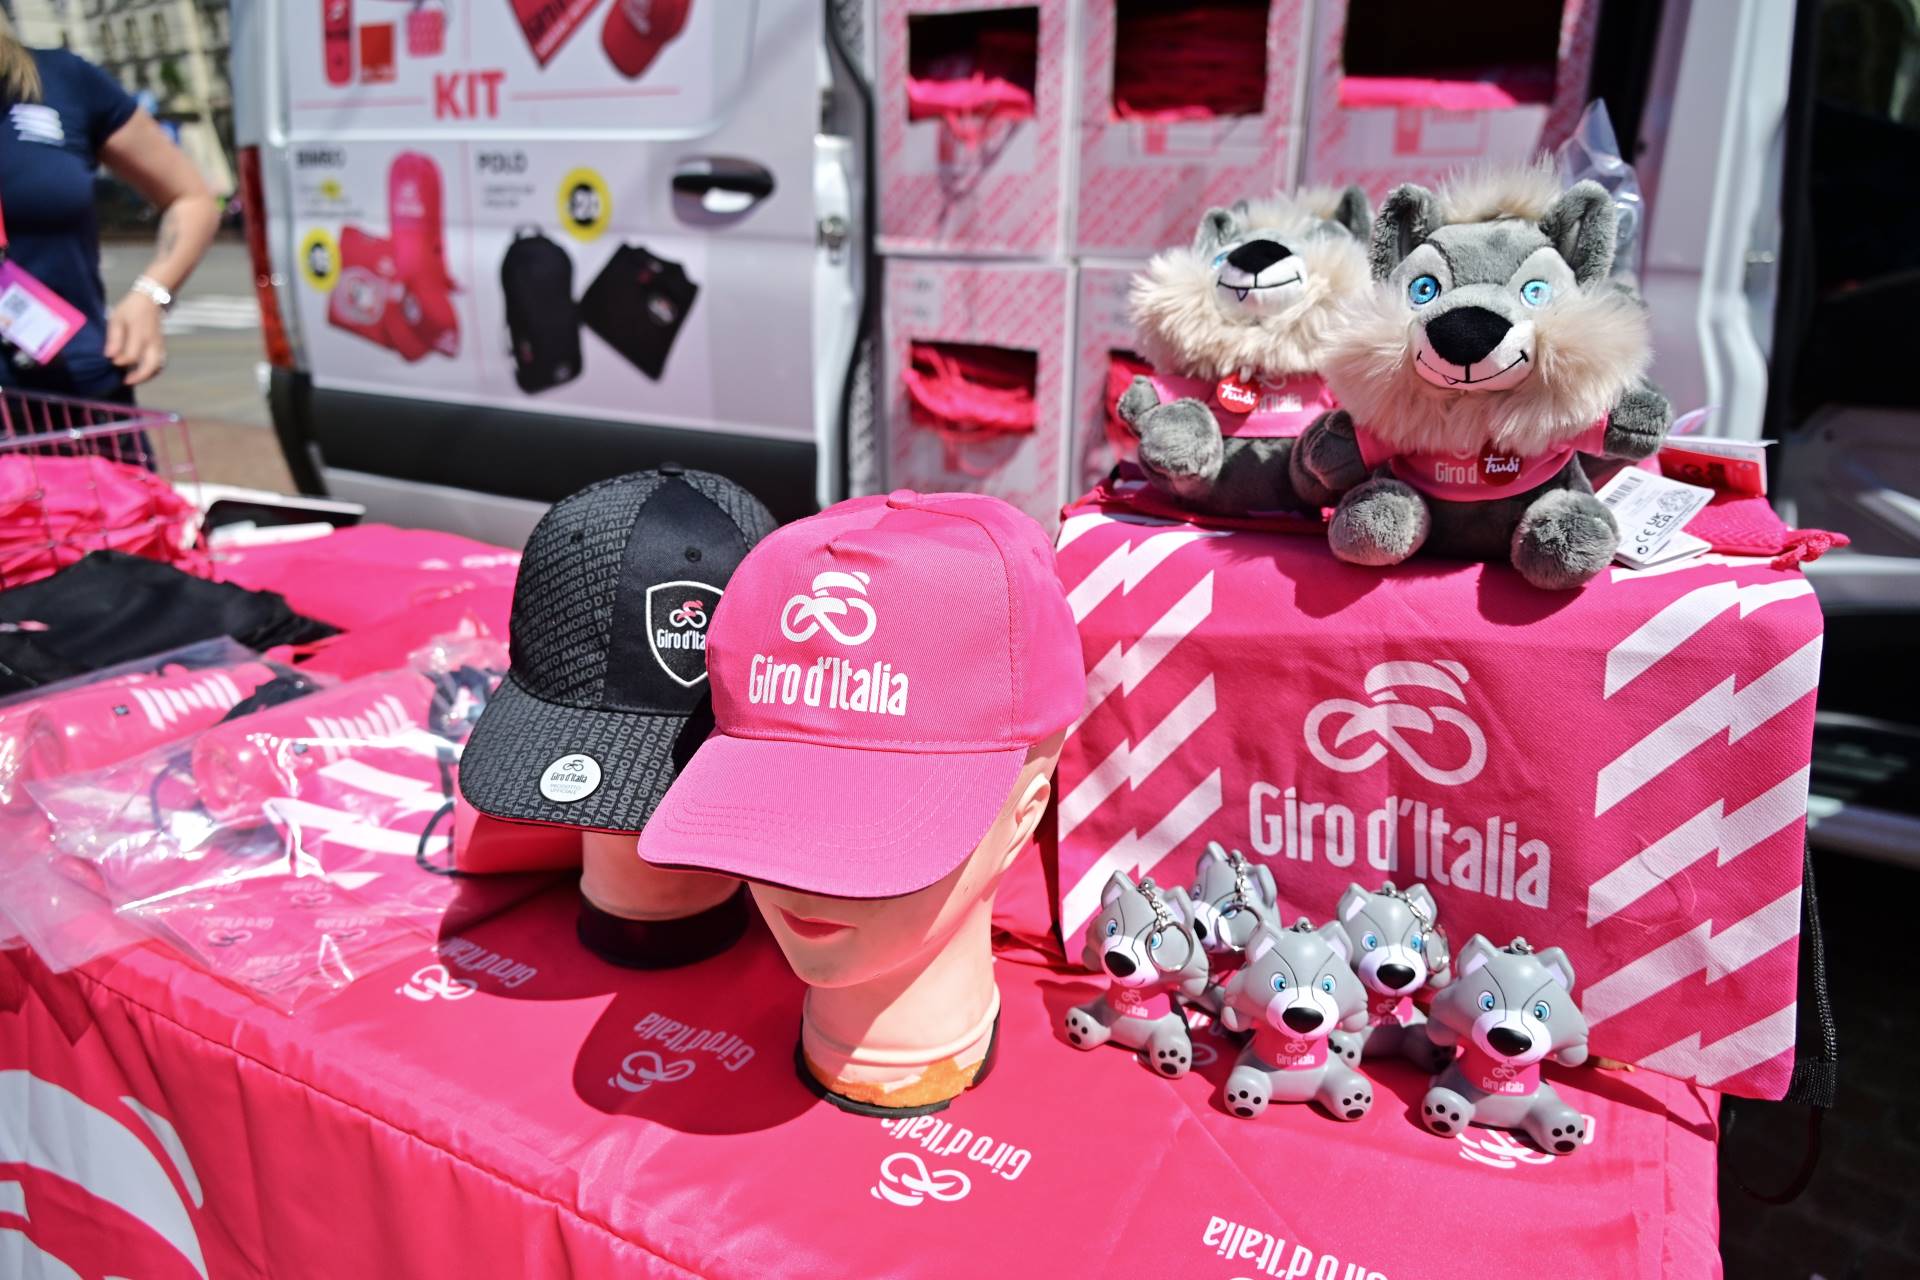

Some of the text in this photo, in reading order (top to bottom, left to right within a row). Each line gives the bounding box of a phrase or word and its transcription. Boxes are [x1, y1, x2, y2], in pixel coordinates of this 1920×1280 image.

[433, 70, 506, 120] KIT
[478, 152, 529, 175] POLO
[1435, 461, 1465, 484] Giro
[656, 629, 682, 650] Giro
[748, 653, 909, 716] Giro d'Italia
[1249, 780, 1550, 910] Giro d'Italia
[700, 1030, 756, 1072] Giro
[967, 1135, 1032, 1181] Giro
[1202, 1215, 1313, 1280] d'Italia
